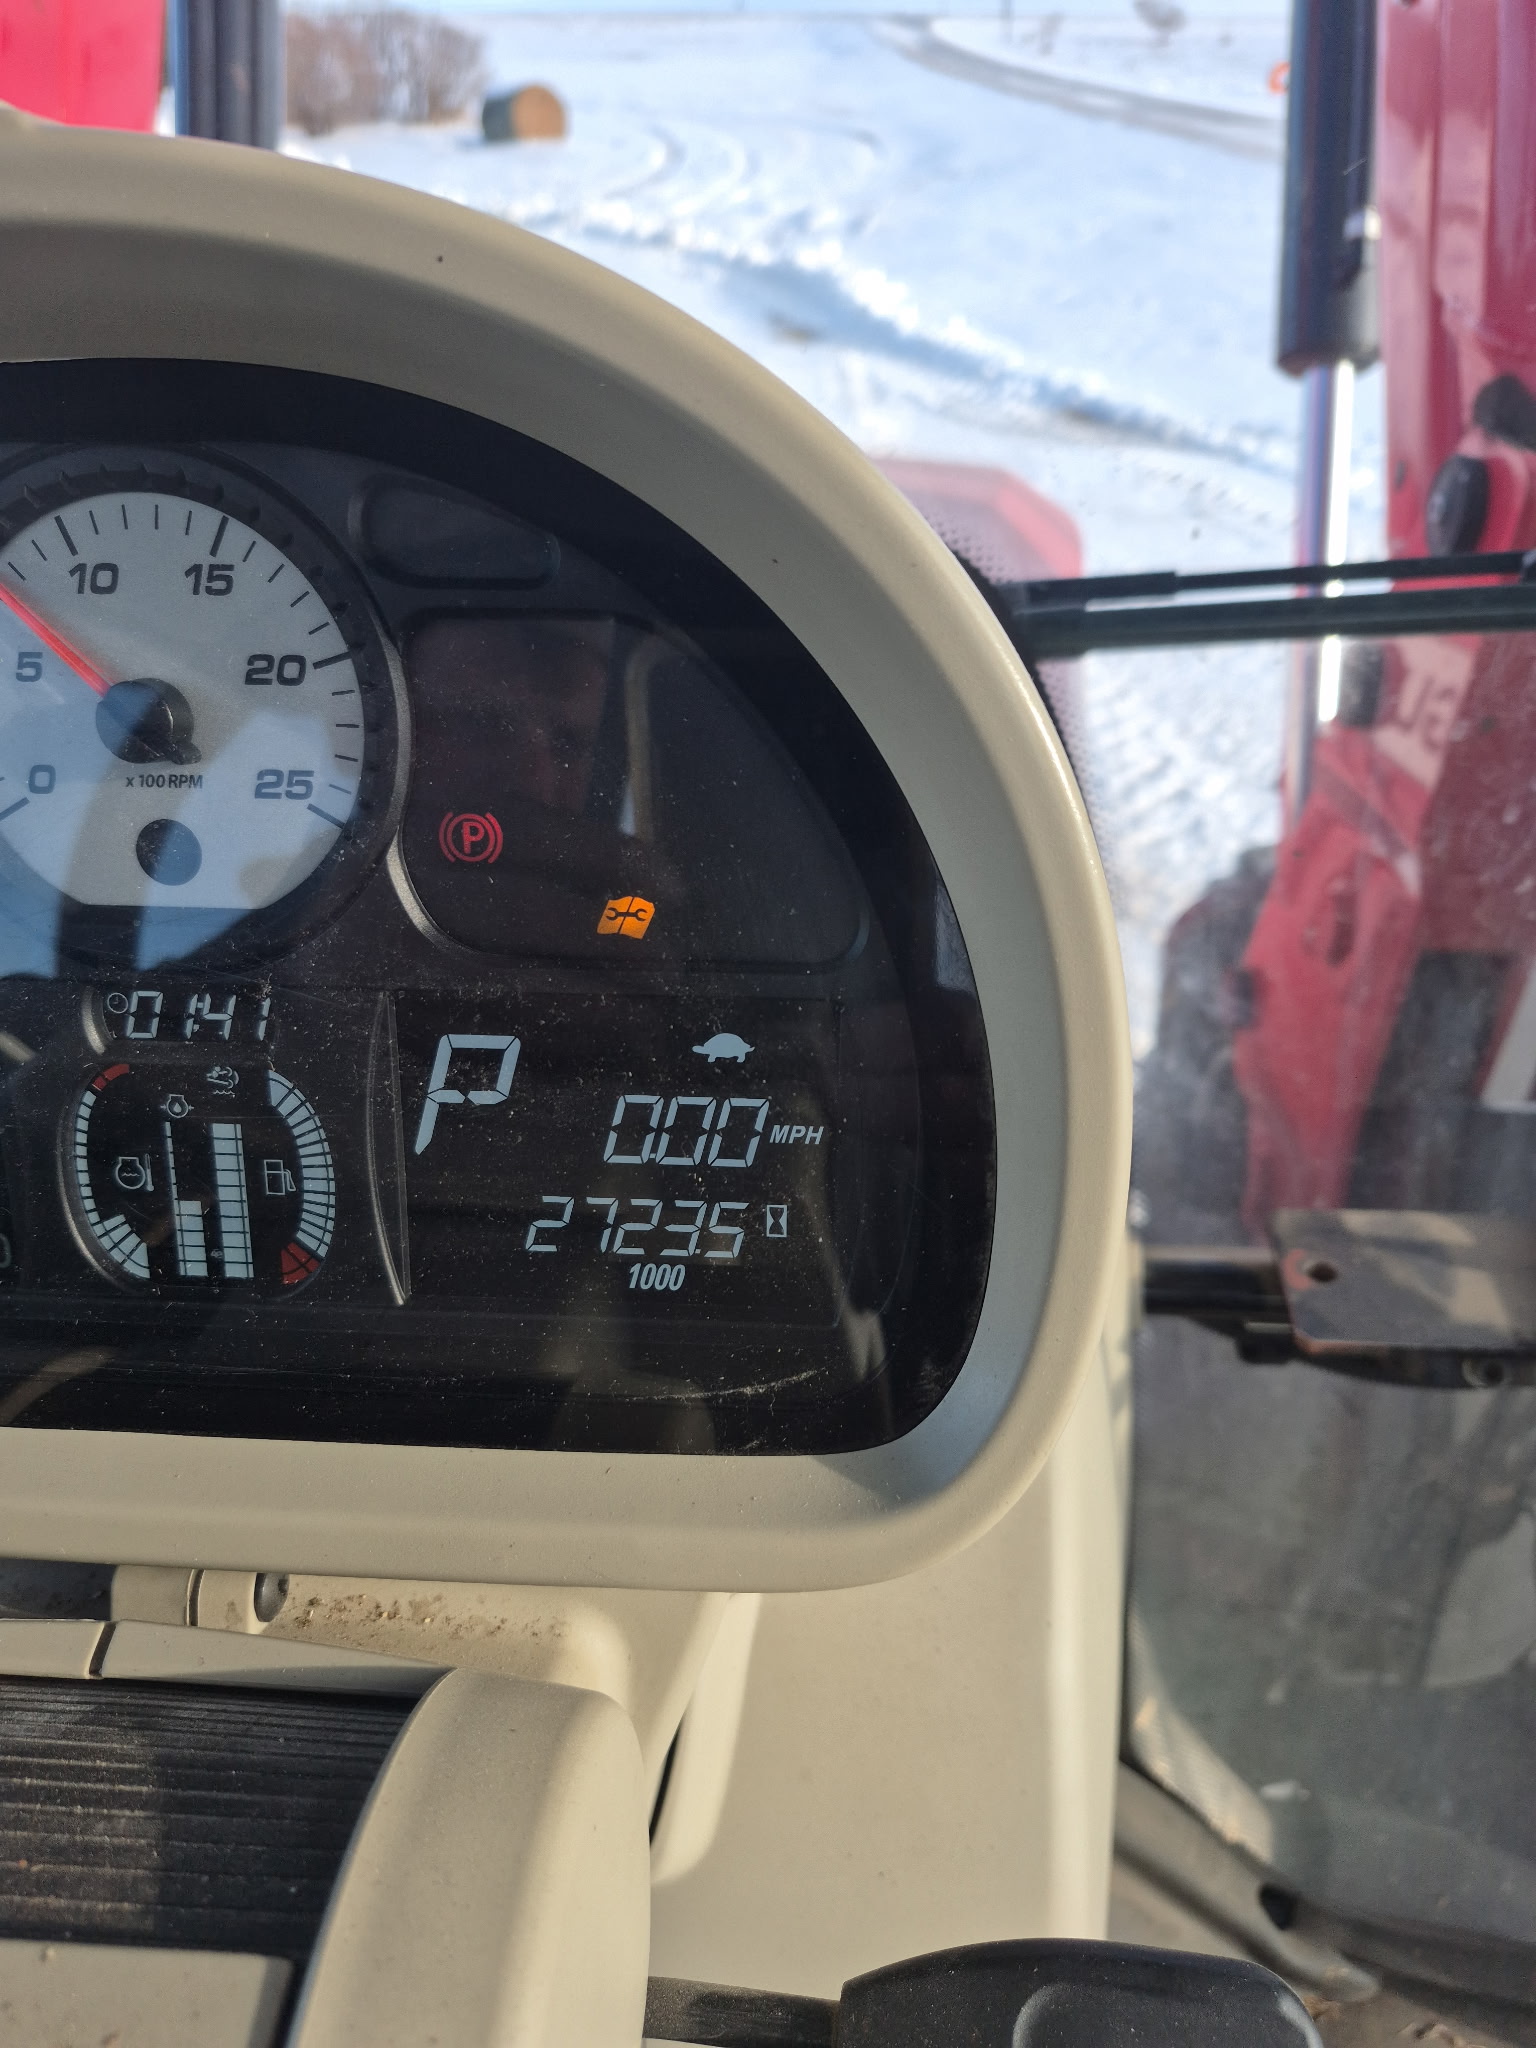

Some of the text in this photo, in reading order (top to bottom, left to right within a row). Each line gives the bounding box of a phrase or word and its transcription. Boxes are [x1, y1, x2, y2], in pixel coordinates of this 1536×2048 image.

[69, 563, 119, 595] 10
[185, 564, 235, 596] 15
[16, 652, 43, 682] 5
[245, 655, 307, 686] 20
[28, 765, 56, 794] 0
[254, 770, 314, 800] 25
[414, 1034, 521, 1155] P
[770, 1124, 824, 1145] MPH
[629, 1263, 686, 1291] 1000
